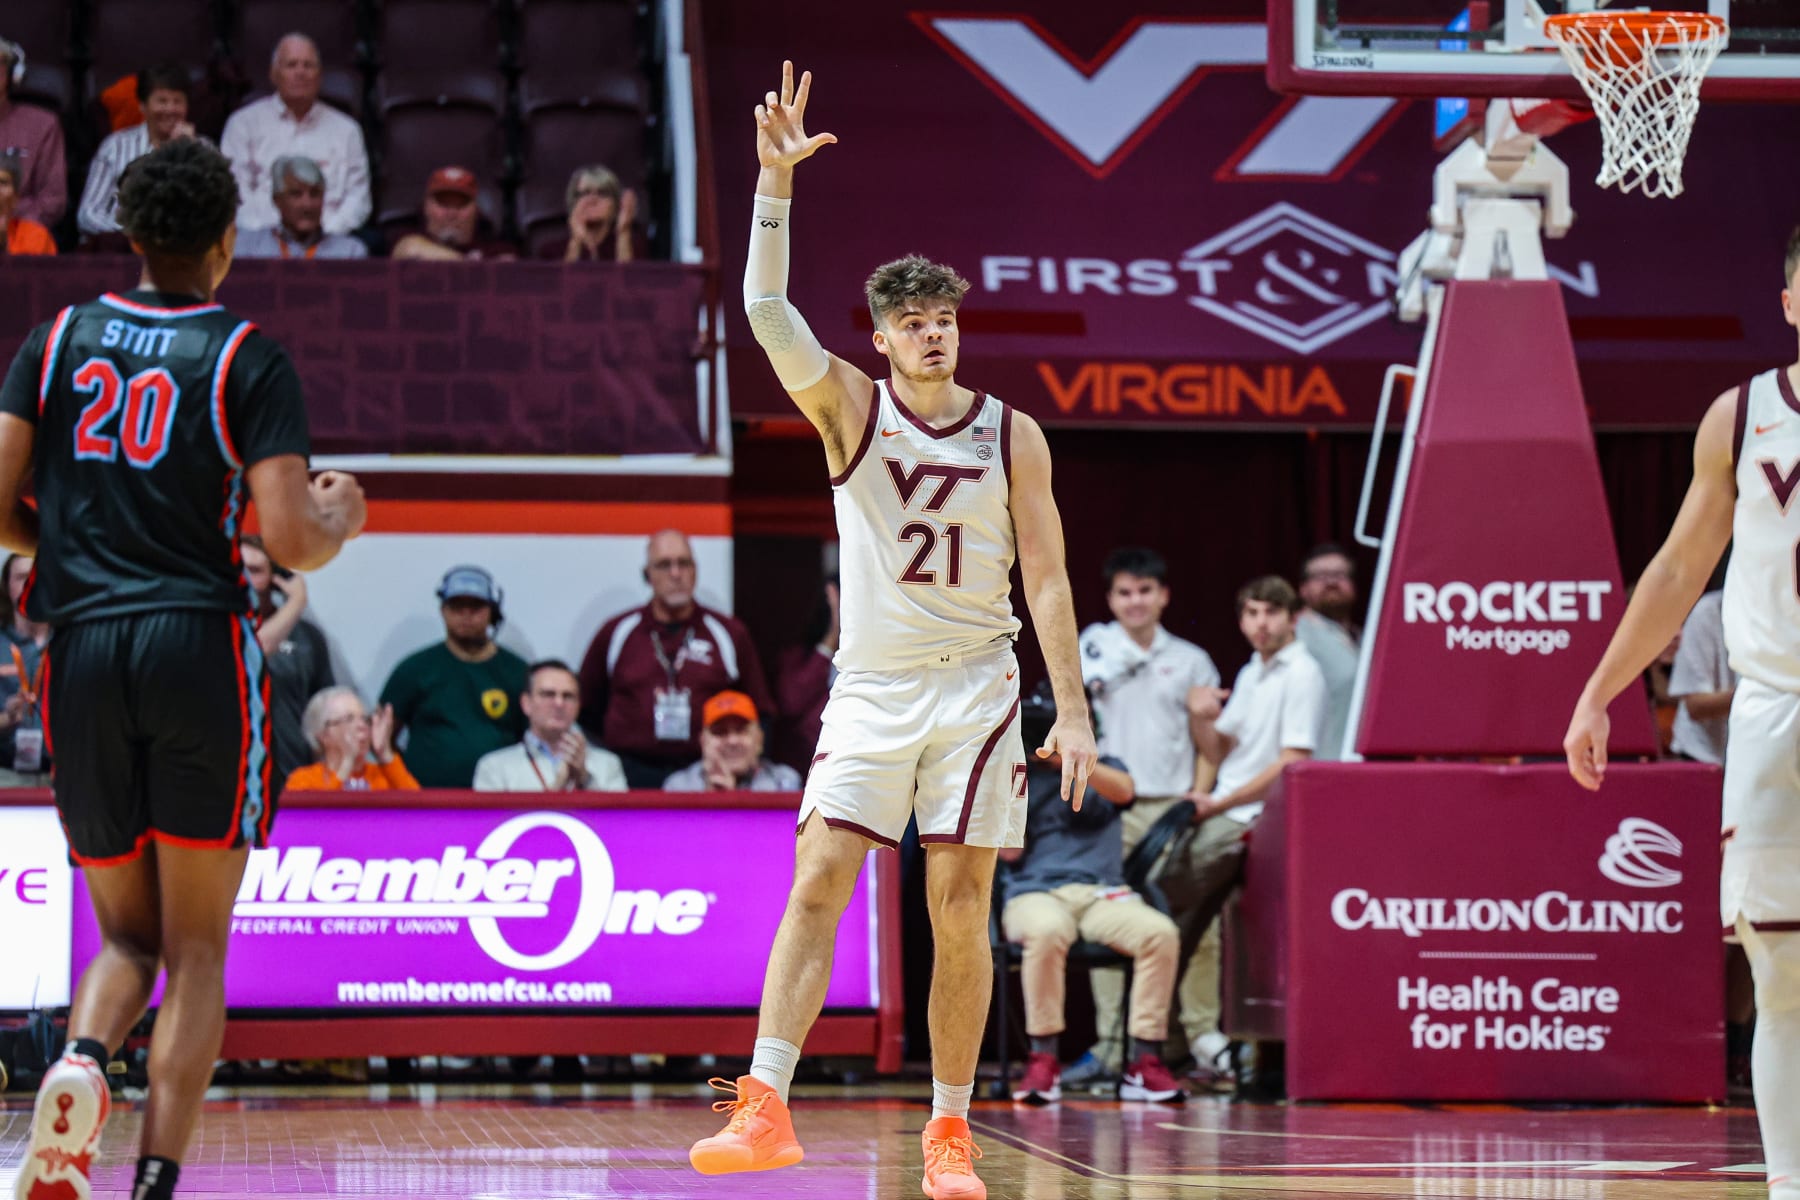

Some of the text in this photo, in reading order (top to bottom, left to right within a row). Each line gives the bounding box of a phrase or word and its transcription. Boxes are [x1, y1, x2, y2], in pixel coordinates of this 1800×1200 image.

[981, 255, 1233, 297] FIRST
[101, 319, 177, 356] STITT
[1035, 360, 1347, 417] VIRGINIA
[73, 356, 180, 469] 20
[882, 456, 990, 513] VT
[896, 520, 963, 587] 21
[1403, 580, 1612, 623] ROCKET
[1446, 624, 1571, 655] Mortgage
[231, 918, 459, 935] FEDERAL CREDIT UNION
[337, 976, 612, 1002] memberonefcu.com
[1398, 975, 1620, 1013] Health Care
[1410, 1014, 1468, 1050] for
